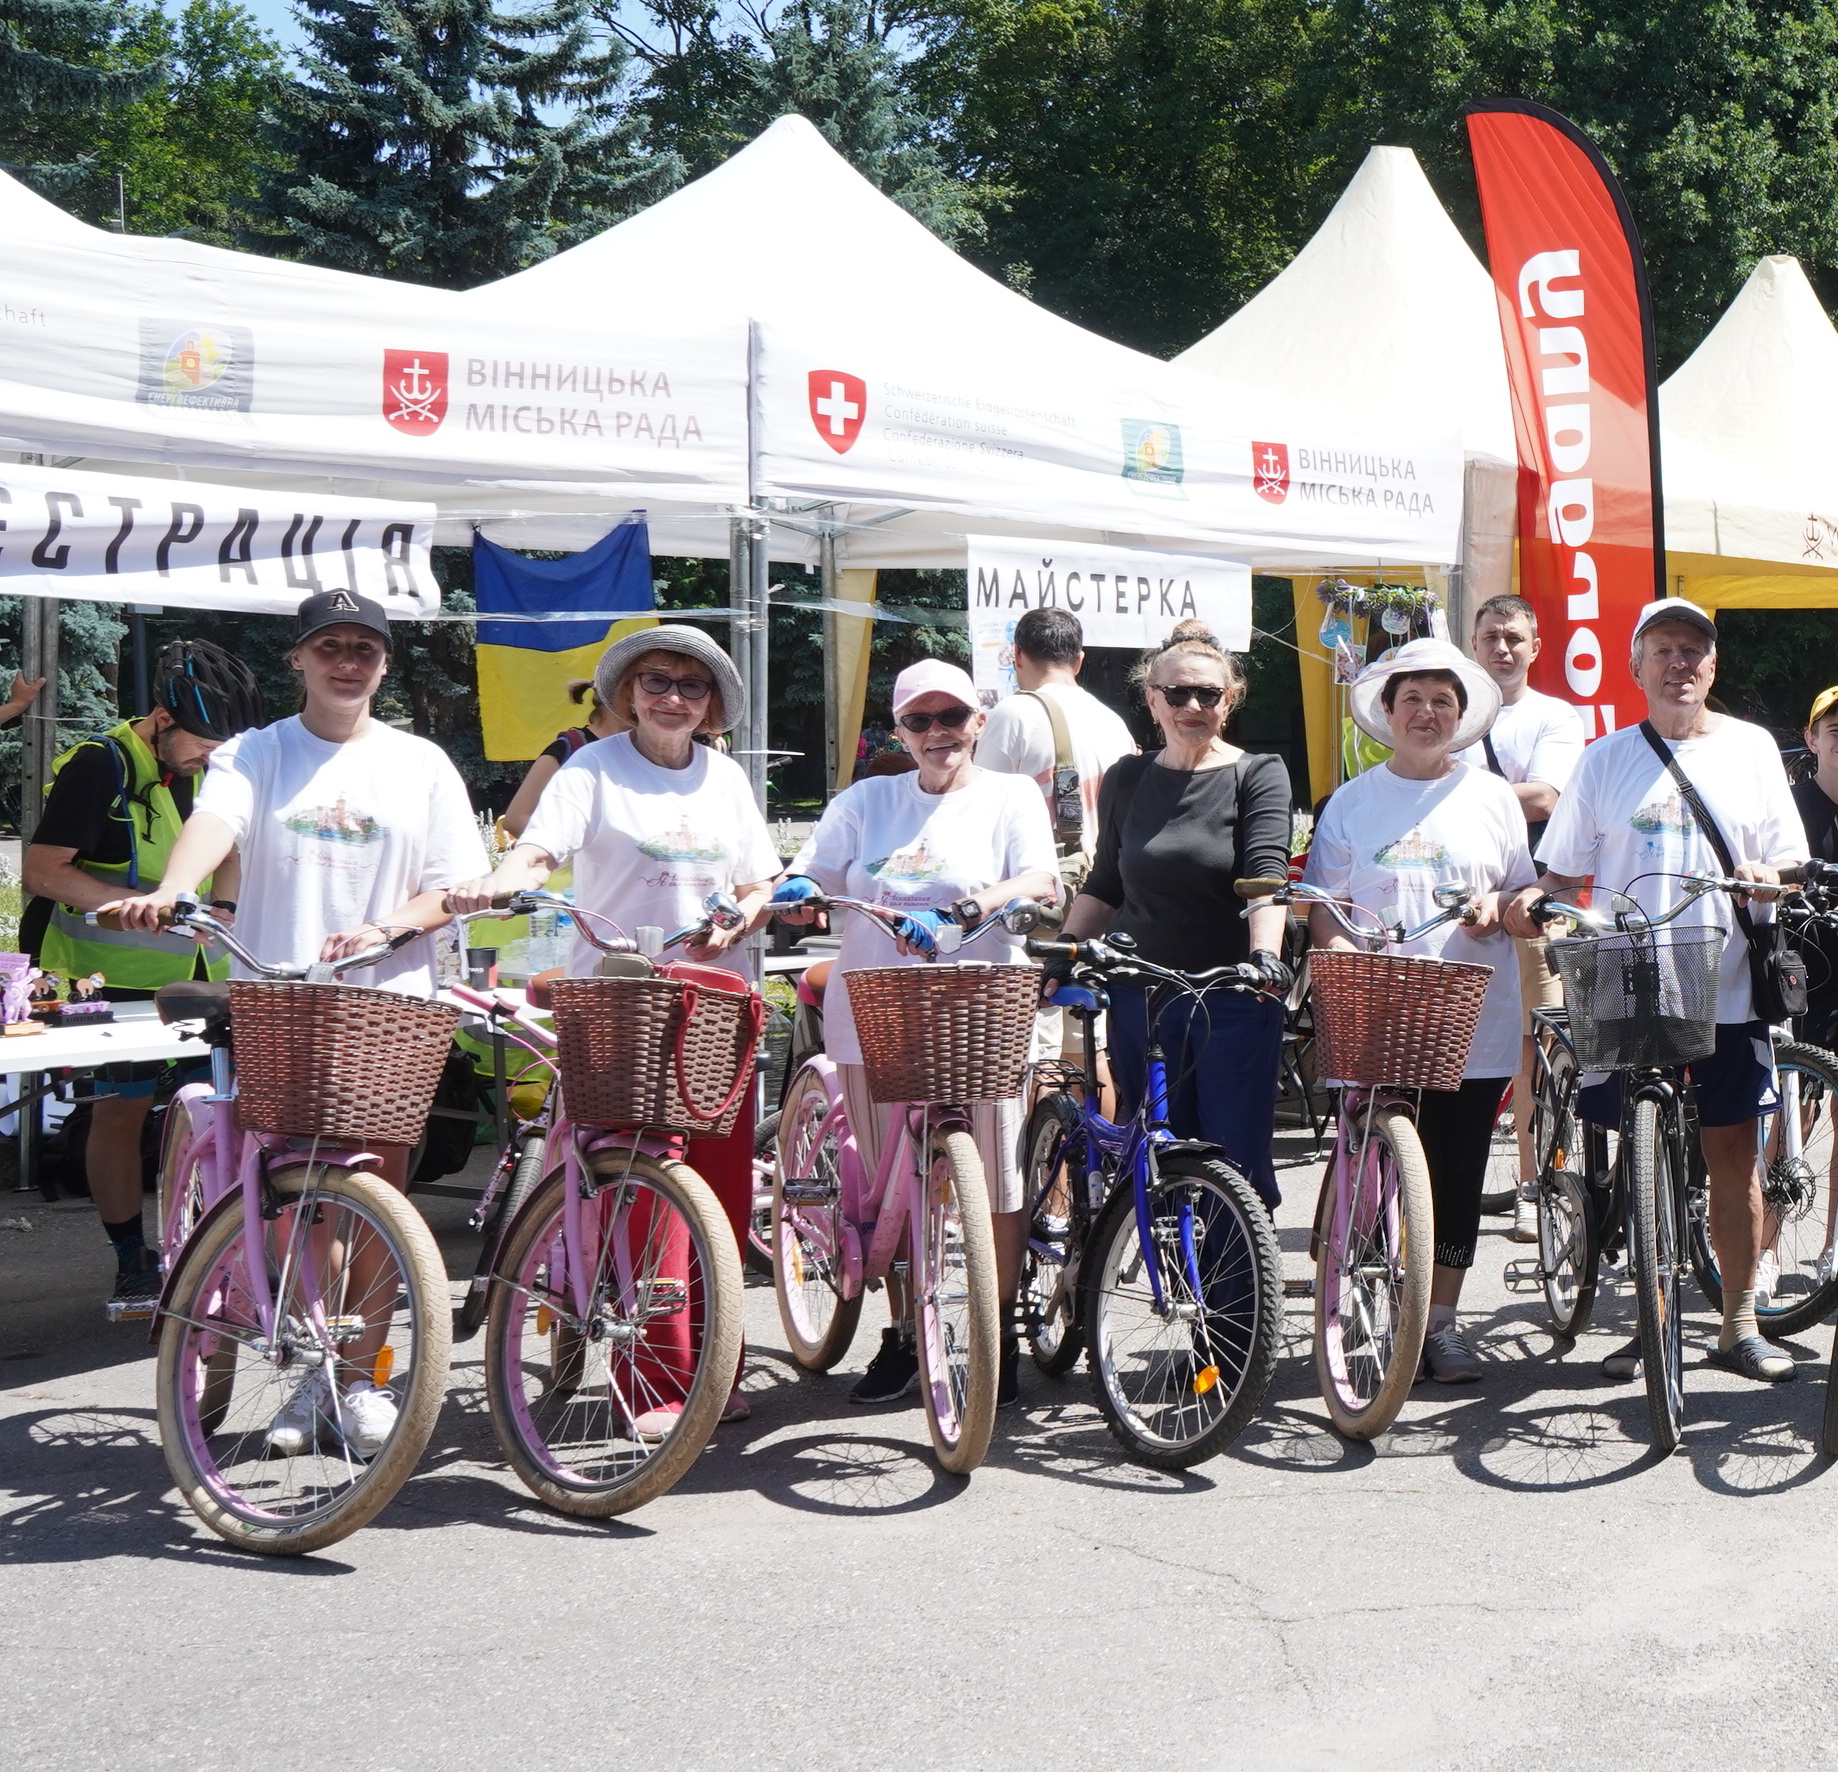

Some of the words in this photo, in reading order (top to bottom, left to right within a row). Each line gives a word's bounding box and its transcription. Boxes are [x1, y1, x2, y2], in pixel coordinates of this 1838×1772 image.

[0, 308, 47, 328] haft
[466, 358, 672, 402] ВІННИЦЬКА
[465, 403, 604, 437] МІСЬКА
[616, 411, 704, 448] РАДА
[979, 442, 1024, 460] Svizzera
[1298, 448, 1417, 482] ВІННИЦЬКА
[1300, 482, 1377, 508] МІСЬКА
[1384, 490, 1435, 518] РАДА
[976, 558, 1197, 618] МАЙСТЕРКА
